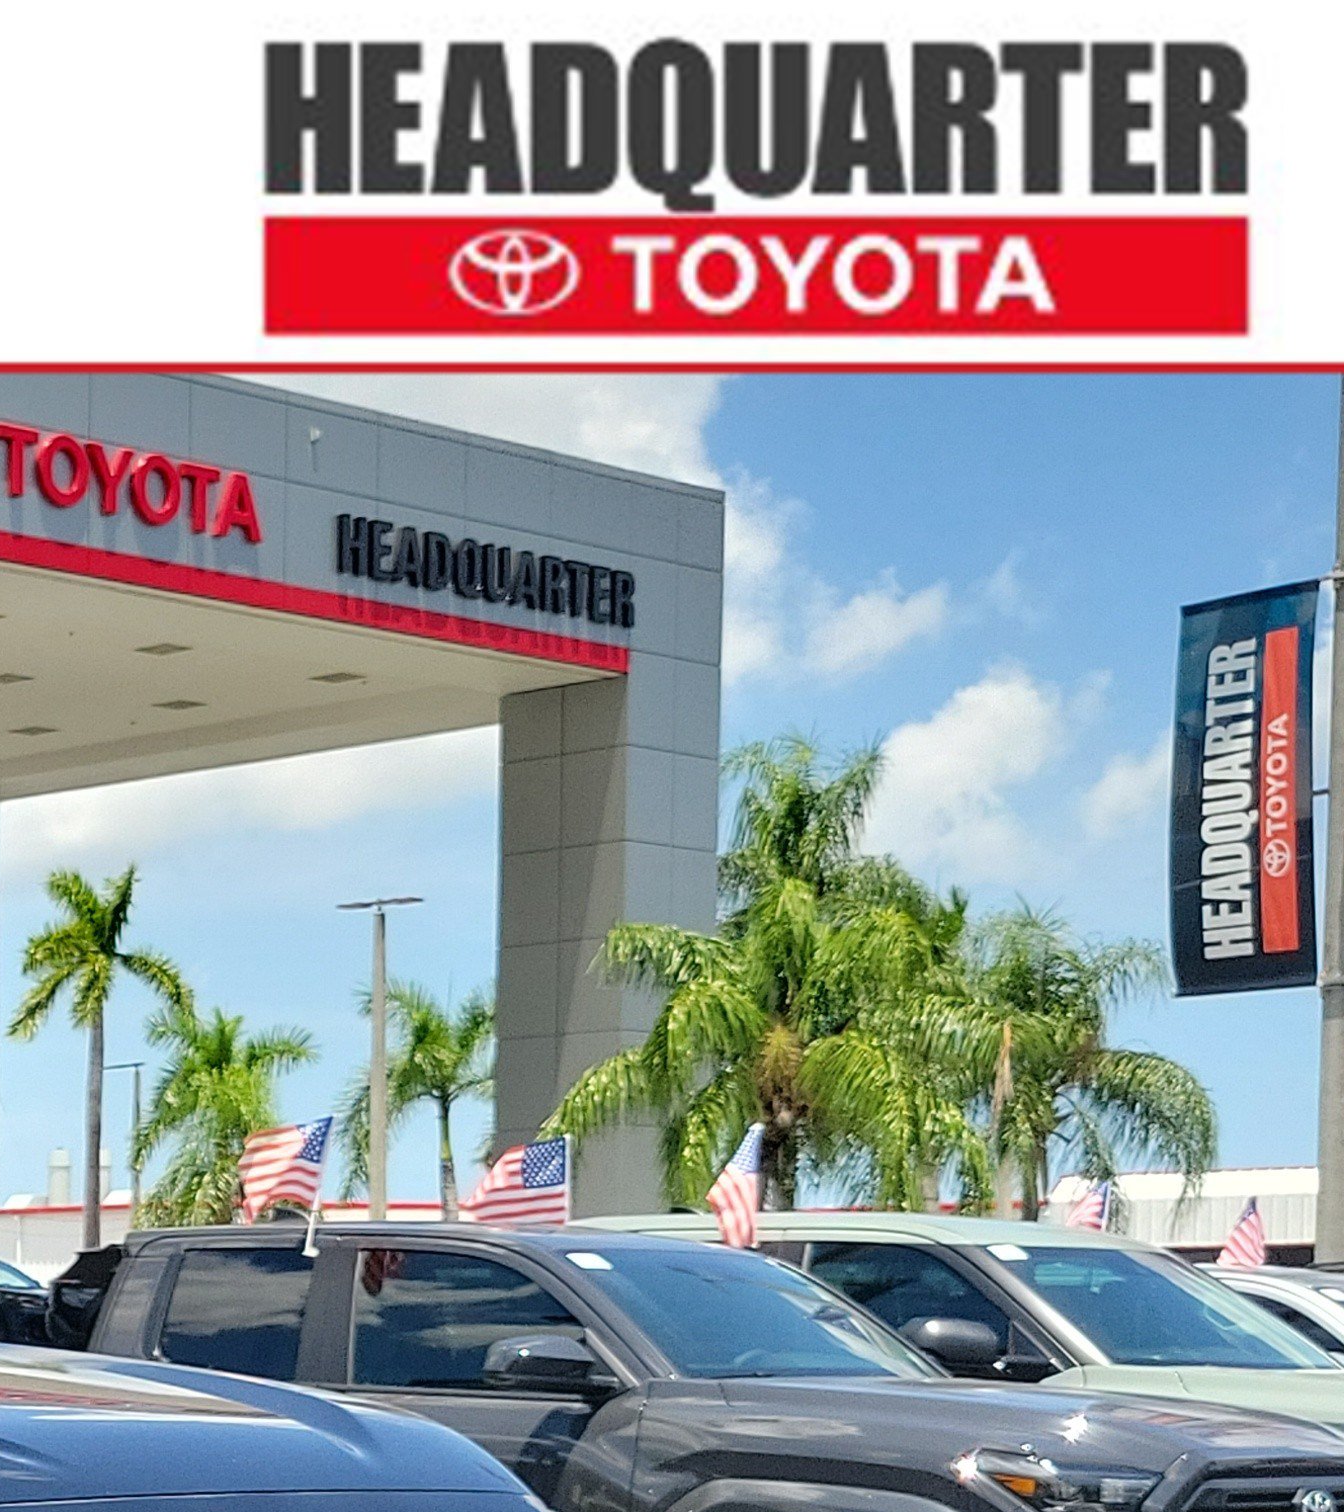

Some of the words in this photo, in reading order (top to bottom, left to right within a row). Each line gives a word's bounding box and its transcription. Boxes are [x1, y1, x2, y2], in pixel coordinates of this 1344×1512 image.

[336, 513, 635, 628] HEADQUARTER
[1200, 636, 1258, 961] HEADQUARTER
[1265, 713, 1290, 838] TOYOTA
